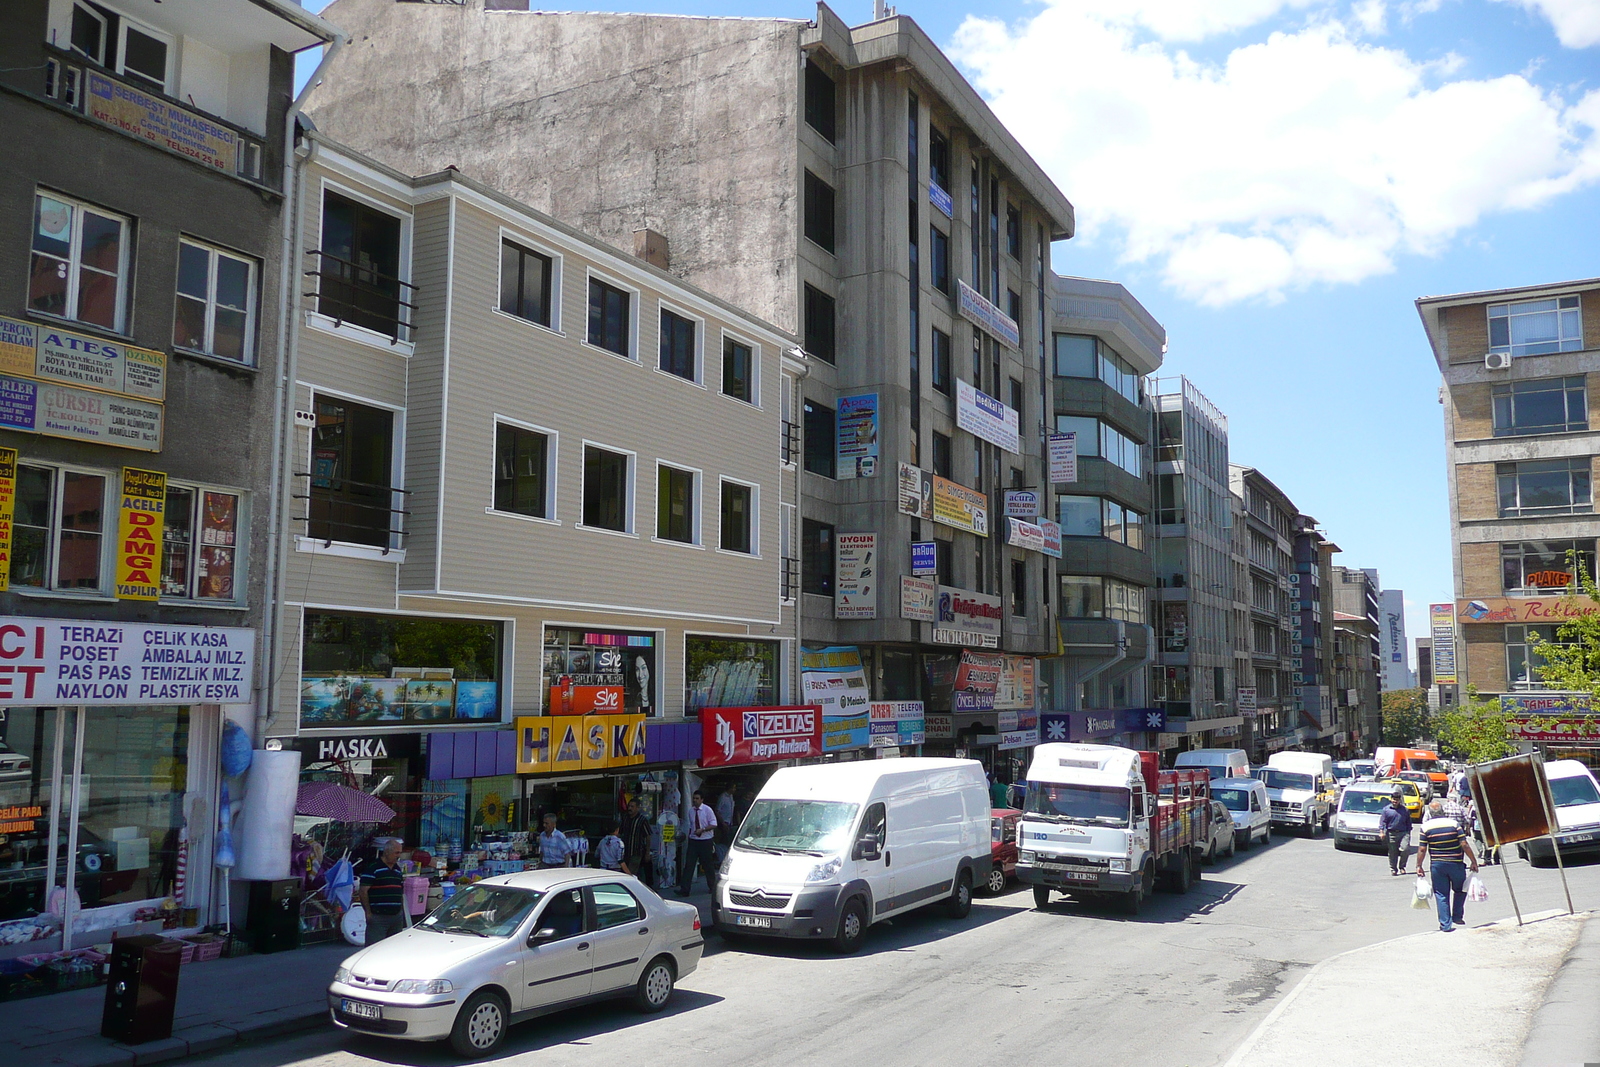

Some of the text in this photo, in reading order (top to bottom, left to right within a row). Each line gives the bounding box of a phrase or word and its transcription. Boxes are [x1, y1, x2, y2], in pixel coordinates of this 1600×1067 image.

[115, 86, 166, 114] SERBEST
[140, 119, 169, 136] Cemal
[202, 154, 213, 164] 25
[43, 333, 118, 361] ATEŞ
[40, 364, 83, 380] PAZARLAMA
[46, 356, 113, 376] BOYA VE HIRDAVAT
[45, 420, 70, 431] Mehmet
[122, 497, 163, 513] ACELE
[1009, 494, 1035, 502] acura
[840, 535, 874, 543] UYGUN
[913, 545, 934, 556] BRAUN
[1527, 570, 1574, 587] PLAKET
[116, 584, 158, 598] YAPILIR
[191, 632, 228, 648] KASA
[1387, 612, 1402, 652] Radisson
[142, 648, 247, 665] AMBALAJ MLZ.
[599, 649, 622, 667] She
[58, 664, 131, 680] PAS PAS
[212, 667, 244, 682] MLZ.
[56, 683, 128, 699] NAYLON
[205, 685, 240, 701] EŞYA
[594, 688, 618, 707] She
[897, 703, 923, 712] TELEFON
[957, 693, 975, 708] ÖNCEL
[871, 723, 896, 733] Panasonic
[901, 721, 921, 732] SIEMENS
[522, 719, 646, 764] HASKA
[1003, 735, 1022, 745] Pelsan
[319, 737, 388, 760] HASKA
[752, 741, 778, 758] Derya
[22, 806, 42, 818] PARA
[1033, 832, 1048, 841] 120
